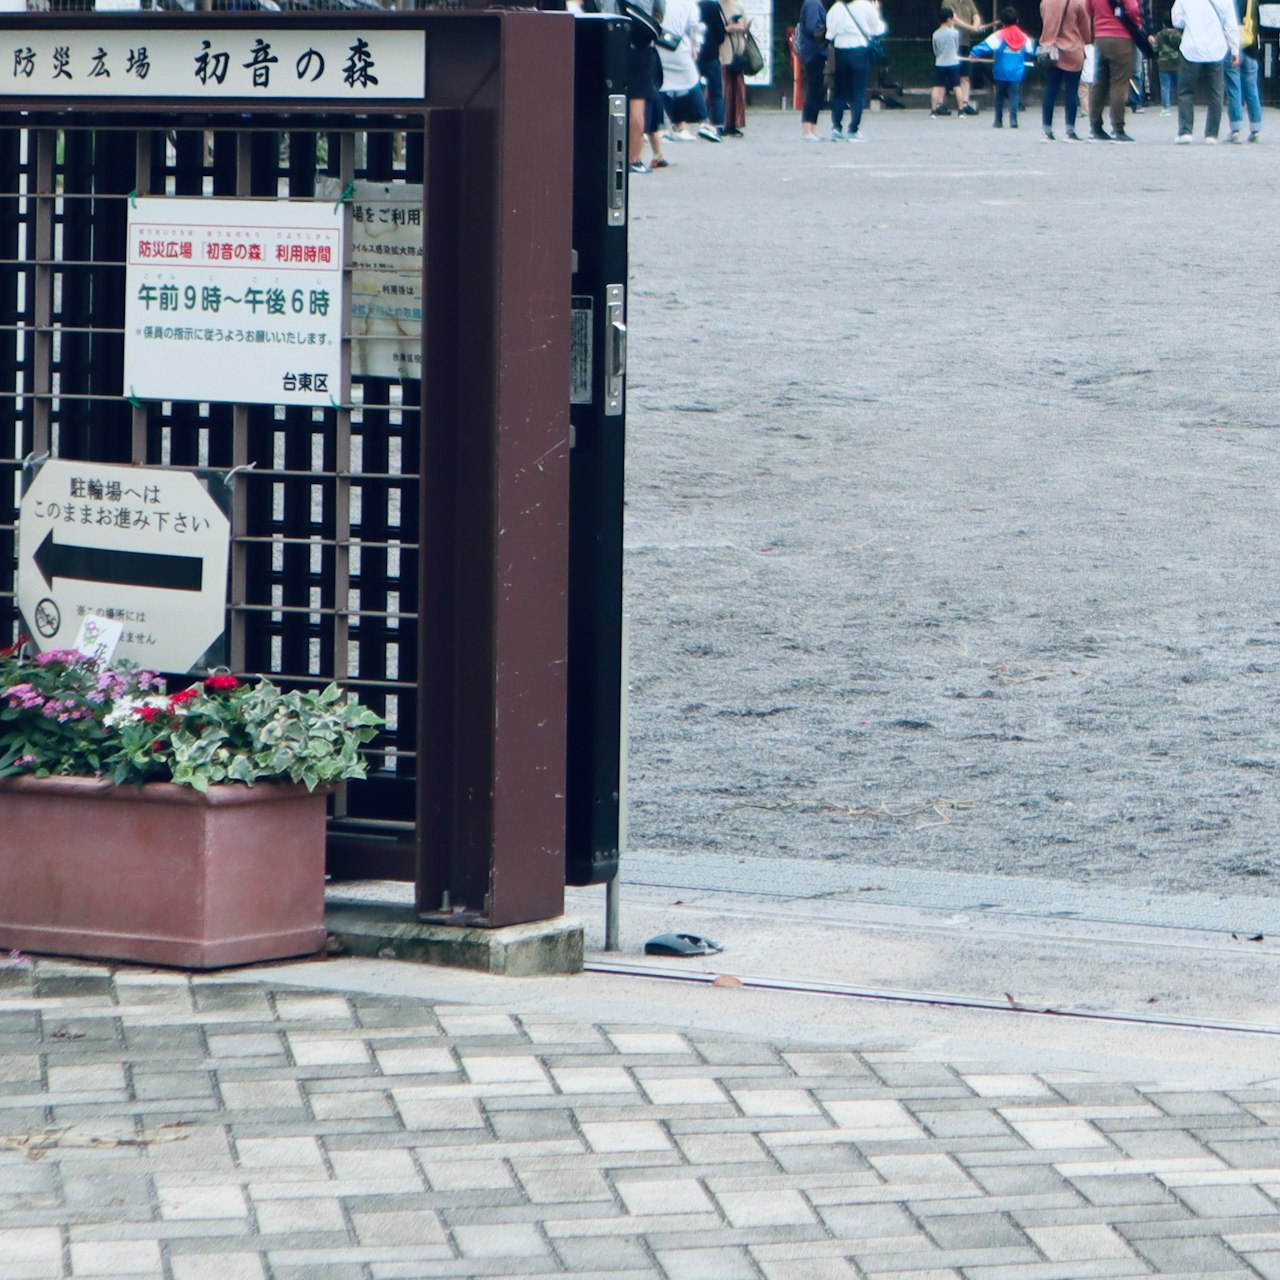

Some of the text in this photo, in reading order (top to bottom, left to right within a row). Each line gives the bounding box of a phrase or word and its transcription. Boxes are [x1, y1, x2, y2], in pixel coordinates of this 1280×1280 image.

[13, 38, 379, 88] 防災広場 初音の森
[138, 240, 193, 259] 防災広場
[275, 244, 331, 263] 利用時間
[282, 372, 329, 393] 台東区
[70, 477, 162, 504] 駐輪場へは
[33, 500, 211, 534] このままお進み下さい
